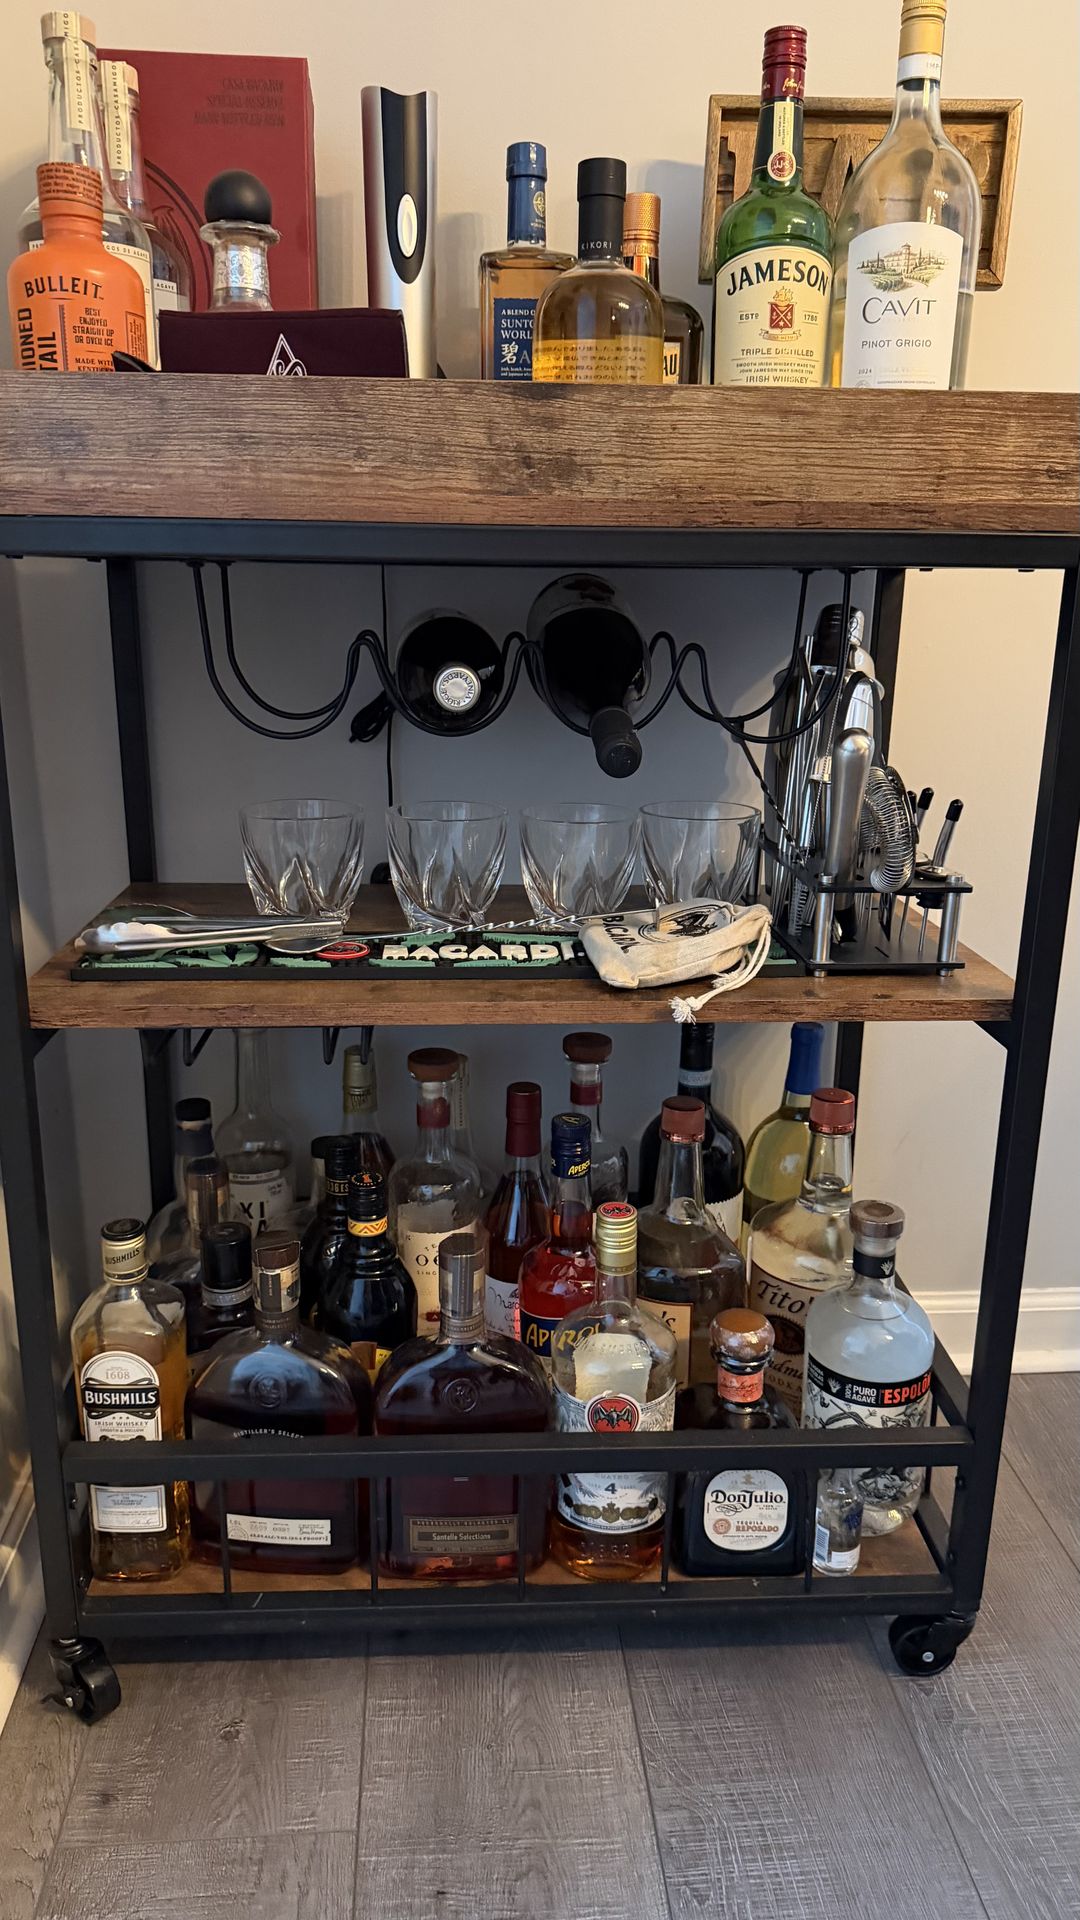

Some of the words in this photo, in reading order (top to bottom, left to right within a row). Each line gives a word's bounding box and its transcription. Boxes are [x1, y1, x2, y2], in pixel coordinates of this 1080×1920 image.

[726, 259, 829, 296] JAMESON
[24, 275, 102, 299] BULLEIT
[156, 283, 175, 291] AGAVE
[84, 307, 101, 317] BEST
[862, 297, 937, 324] CAVIT
[79, 317, 108, 327] ENJOYED
[72, 325, 105, 336] STRAIGHT
[106, 329, 115, 338] UP
[75, 335, 85, 344] OR
[104, 338, 114, 347] ICE
[861, 340, 892, 349] PINOT
[895, 339, 932, 348] GRIGIO
[741, 347, 772, 356] TRIPLE
[775, 348, 814, 357] DISTILLED
[773, 376, 809, 384] WHISKEY
[442, 671, 474, 700] VINEYARDS
[104, 1248, 141, 1265] BUSHMILLS
[757, 1280, 815, 1316] Tito'
[105, 1371, 130, 1380] 1608
[853, 1385, 877, 1396] PURO
[85, 1390, 157, 1405] BUSHMILLS
[852, 1395, 876, 1404] AGAVE
[233, 1428, 275, 1438] DISTILLER'S
[604, 1482, 618, 1494] 4
[736, 1525, 779, 1533] REPOSADO
